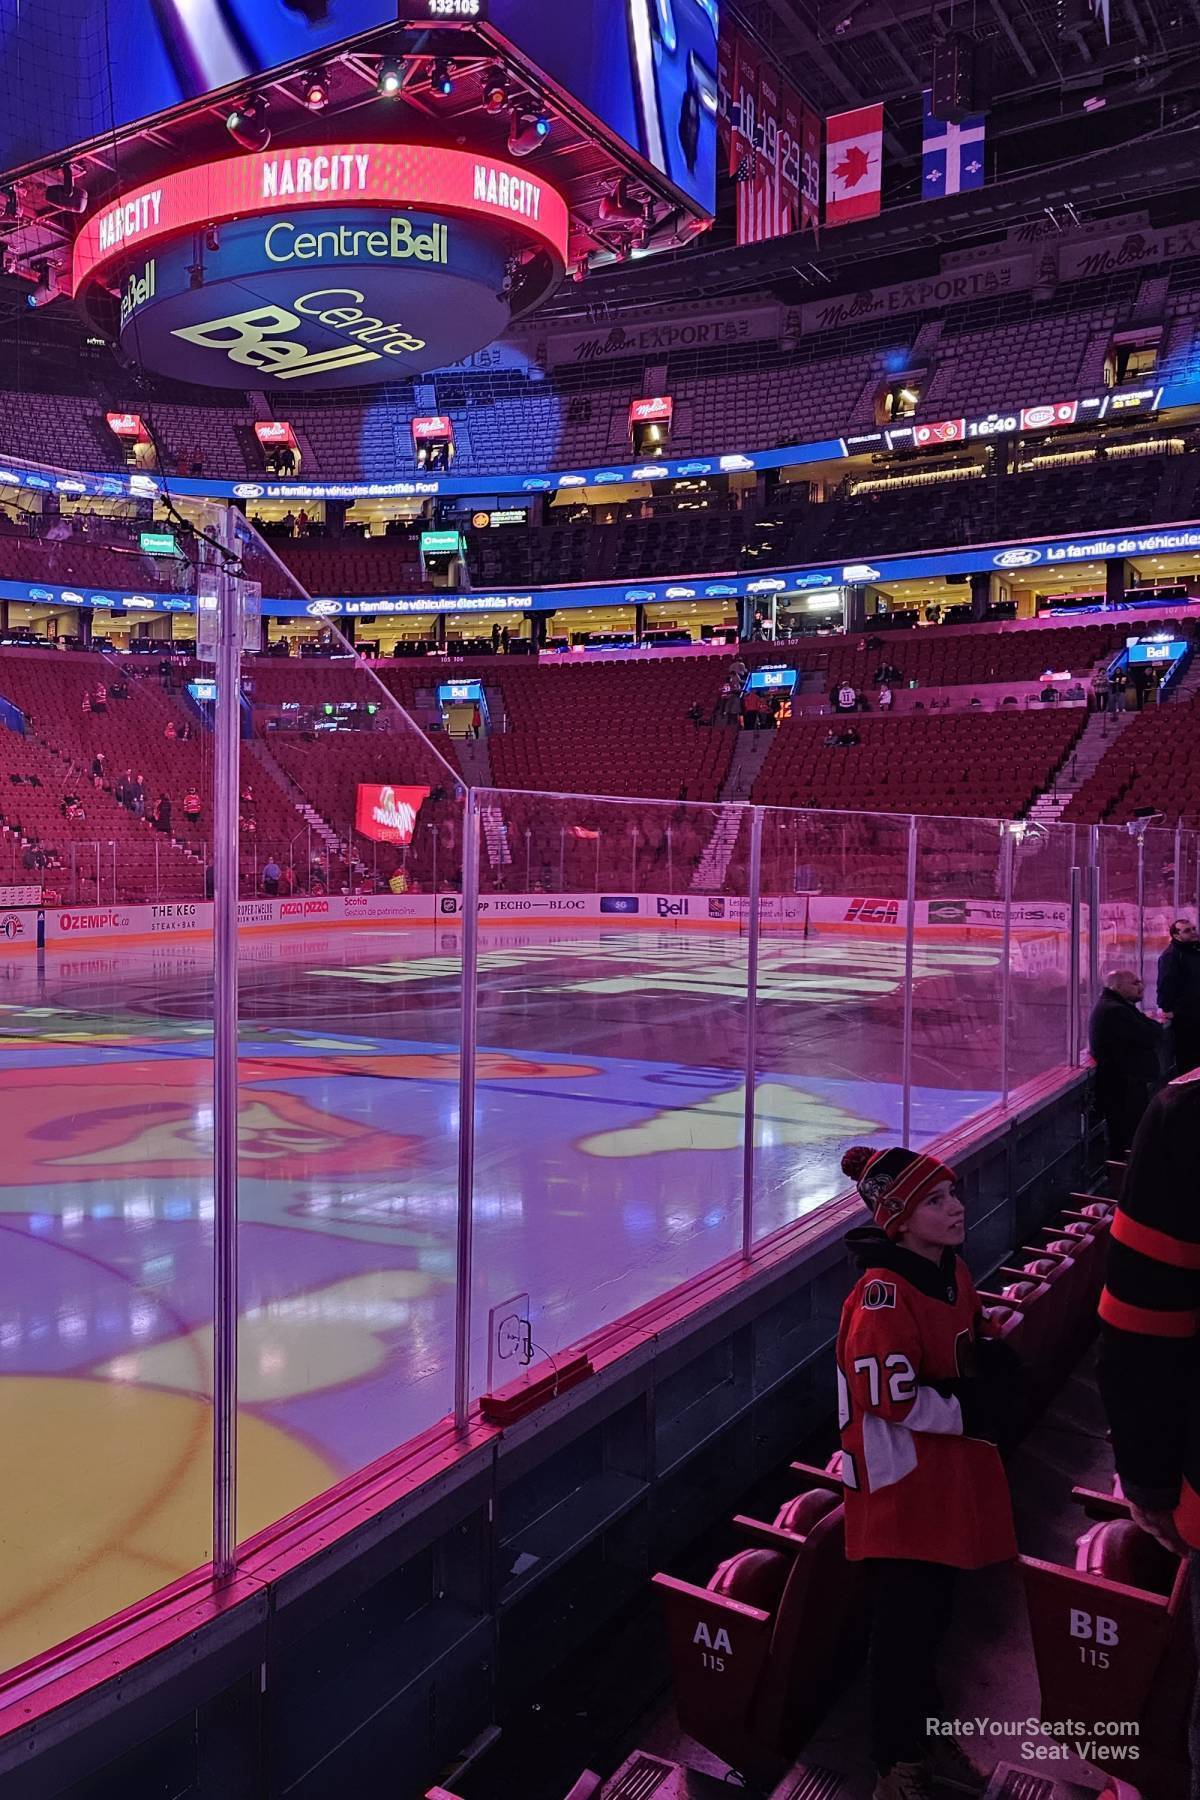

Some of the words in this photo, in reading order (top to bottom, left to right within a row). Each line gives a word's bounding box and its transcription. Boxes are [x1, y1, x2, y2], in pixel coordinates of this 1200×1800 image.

[761, 107, 777, 167] 19
[782, 131, 800, 192] 23
[263, 154, 369, 198] NARCITY
[801, 151, 820, 208] 33
[473, 164, 540, 221] NARCITY
[99, 189, 163, 251] NARCITY
[1076, 243, 1158, 276] Molson
[816, 294, 883, 328] Molson
[887, 274, 983, 312] EXPORT
[293, 288, 427, 355] Centre
[170, 304, 384, 380] Bell
[573, 333, 637, 360] Molson
[639, 322, 727, 350] EXPORT
[635, 402, 668, 416] Molson
[1058, 405, 1071, 419] 0
[110, 418, 136, 429] Molson
[259, 426, 286, 438] Molson
[416, 421, 445, 433] Molson
[968, 417, 1017, 437] 16:40
[918, 428, 930, 440] 0
[268, 486, 280, 496] La
[281, 486, 311, 497] famille
[313, 486, 324, 497] de
[325, 485, 368, 496] véhicules
[368, 484, 415, 495] électrifiés
[416, 483, 438, 493] Ford
[999, 550, 1033, 564] Ford
[1047, 547, 1065, 559] La
[1066, 541, 1112, 557] famille
[1117, 539, 1136, 551] de
[312, 601, 338, 613] Ford
[346, 601, 358, 612] La
[359, 600, 395, 612] famille
[397, 601, 409, 611] de
[409, 599, 456, 611] véhicules
[457, 597, 506, 610] électrifiés
[508, 596, 532, 607] Ford
[1146, 647, 1170, 658] Bell
[764, 672, 782, 684] Bell
[451, 687, 468, 698] Bell
[152, 905, 173, 917] THE
[177, 904, 196, 916] KEG
[280, 903, 302, 919] pizza
[304, 901, 329, 917] pizza
[344, 896, 367, 906] Scotia
[657, 897, 689, 917] Bell
[344, 908, 367, 917] Gestion
[368, 907, 376, 916] de
[843, 898, 899, 925] IGA
[152, 921, 175, 930] STEAK
[854, 1354, 917, 1407] 72
[1069, 1608, 1120, 1648] BB
[692, 1621, 734, 1656] AA
[702, 1652, 725, 1673] 115
[1078, 1646, 1110, 1670] 115
